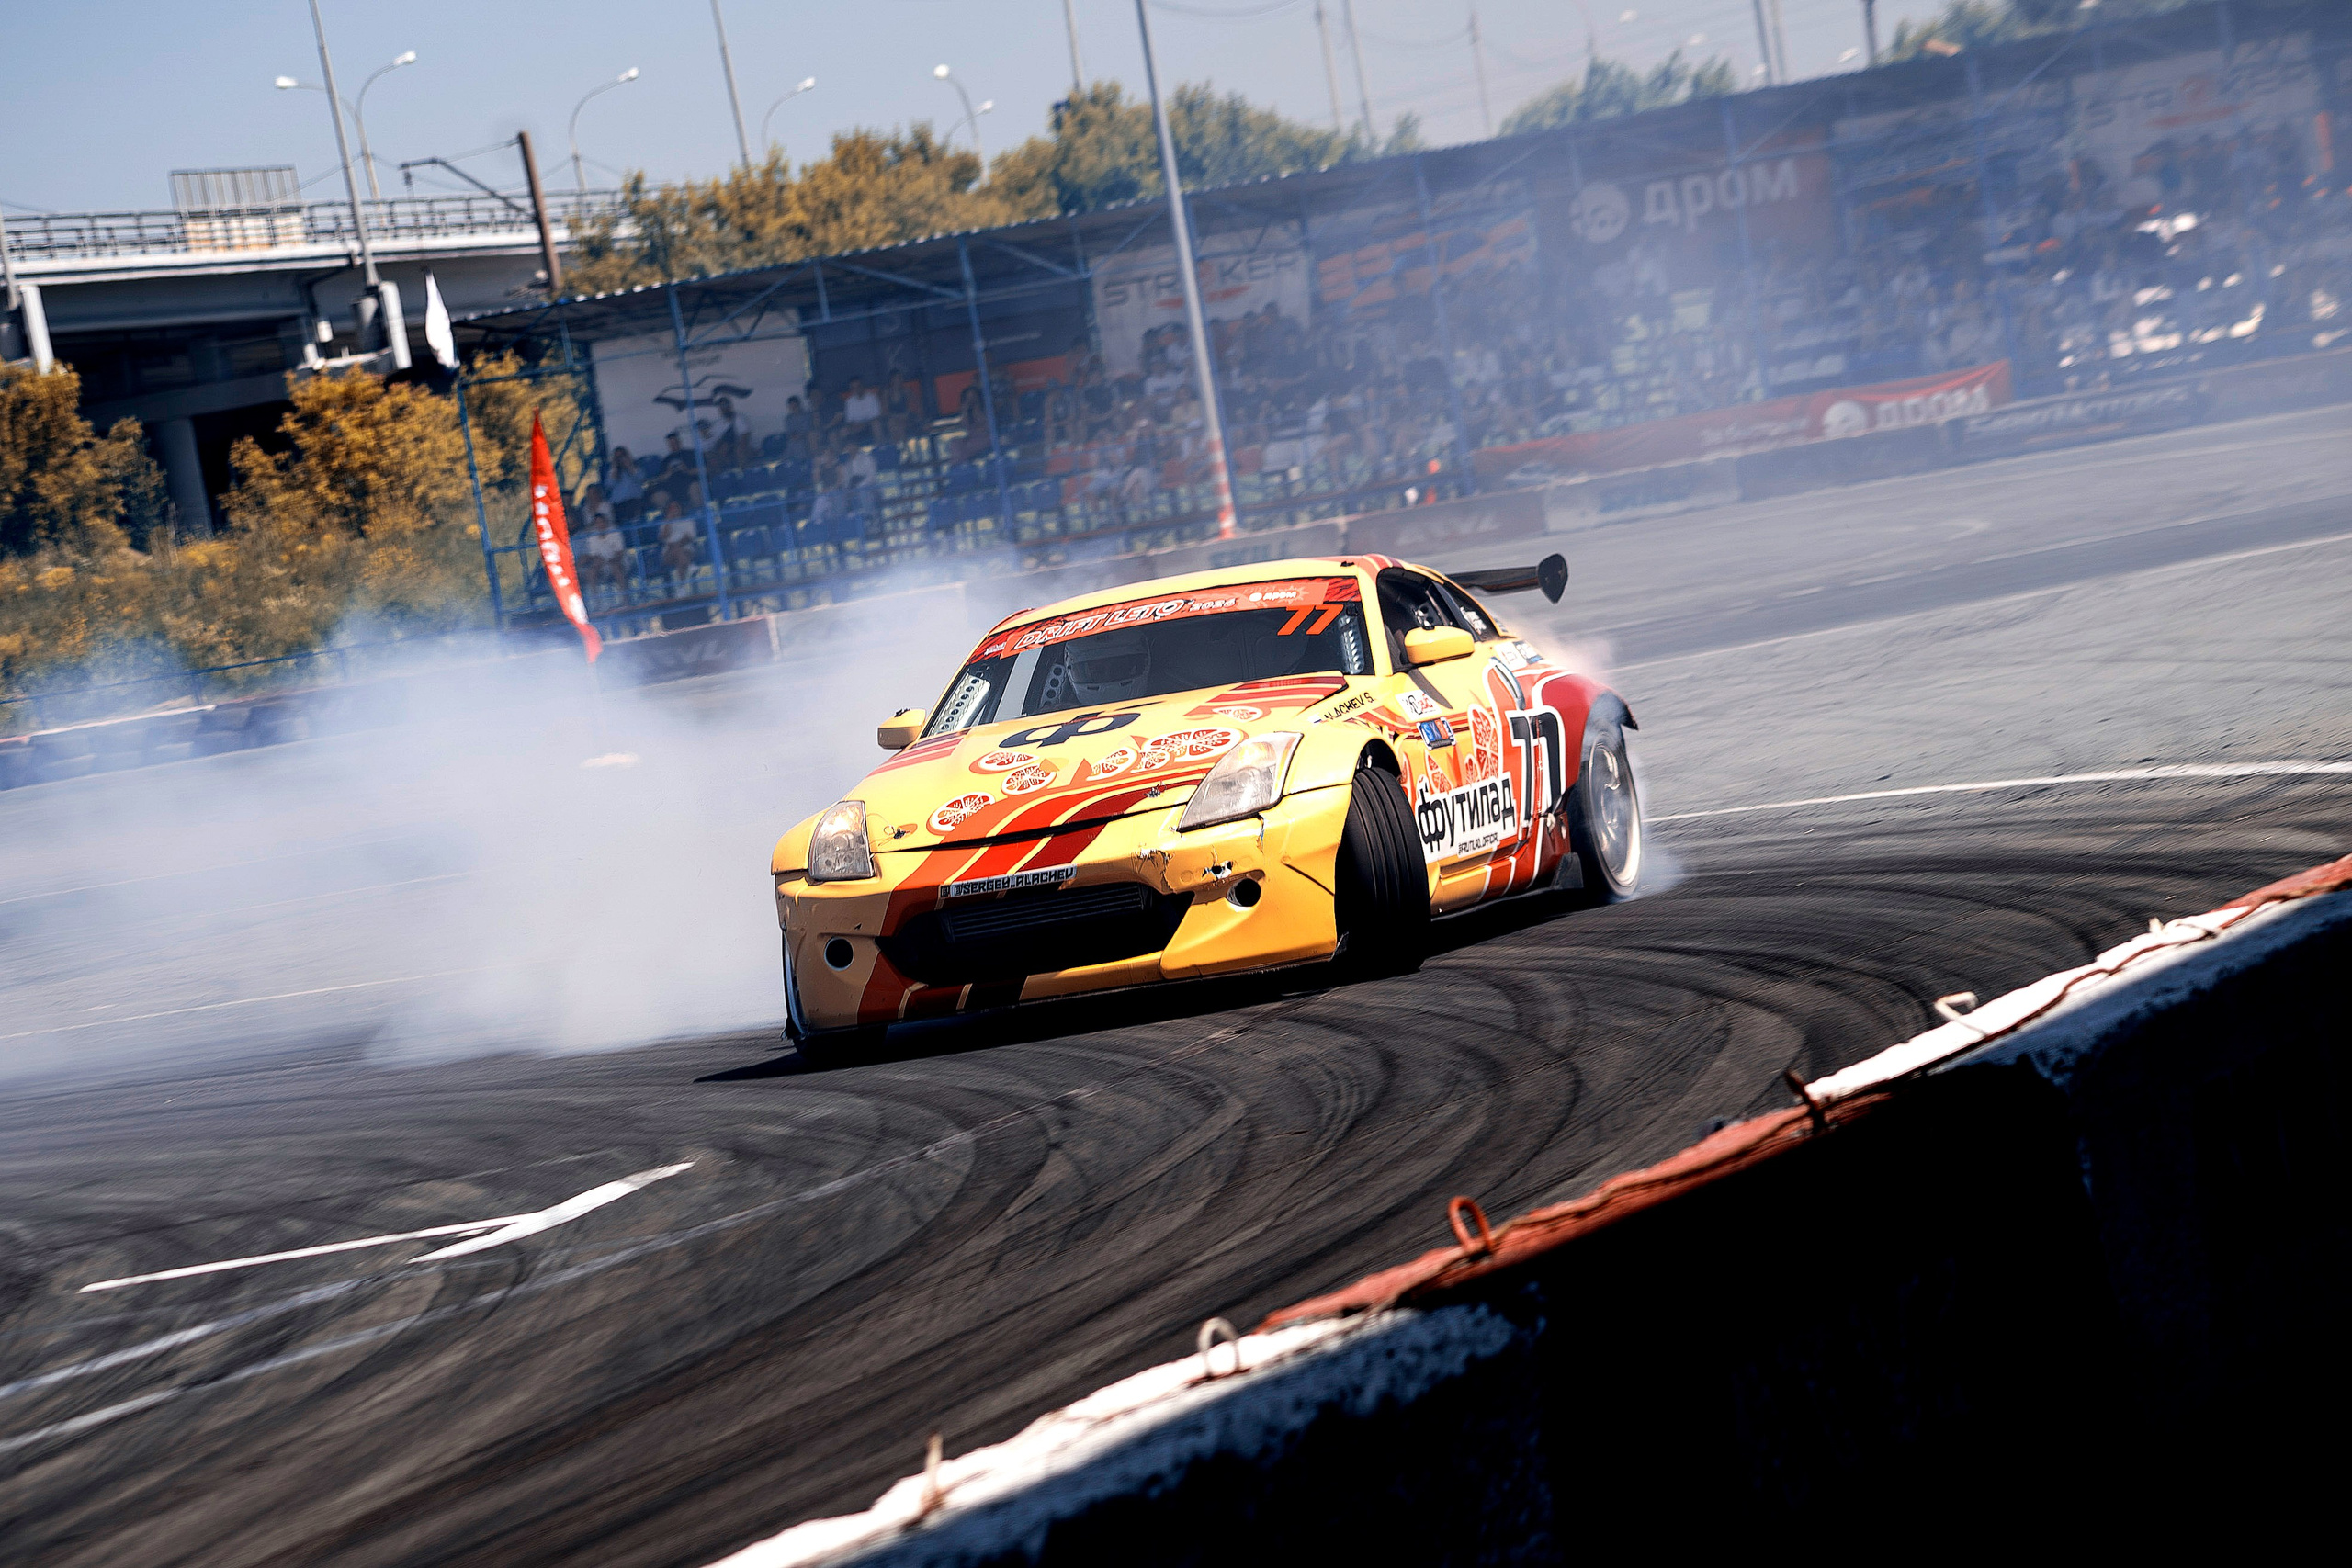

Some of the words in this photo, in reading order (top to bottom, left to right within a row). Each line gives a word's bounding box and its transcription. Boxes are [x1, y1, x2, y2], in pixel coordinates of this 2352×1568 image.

[1013, 613, 1109, 649] DRIFT
[1104, 599, 1185, 626] LETO
[1277, 604, 1344, 636] 77
[1508, 711, 1565, 822] 77
